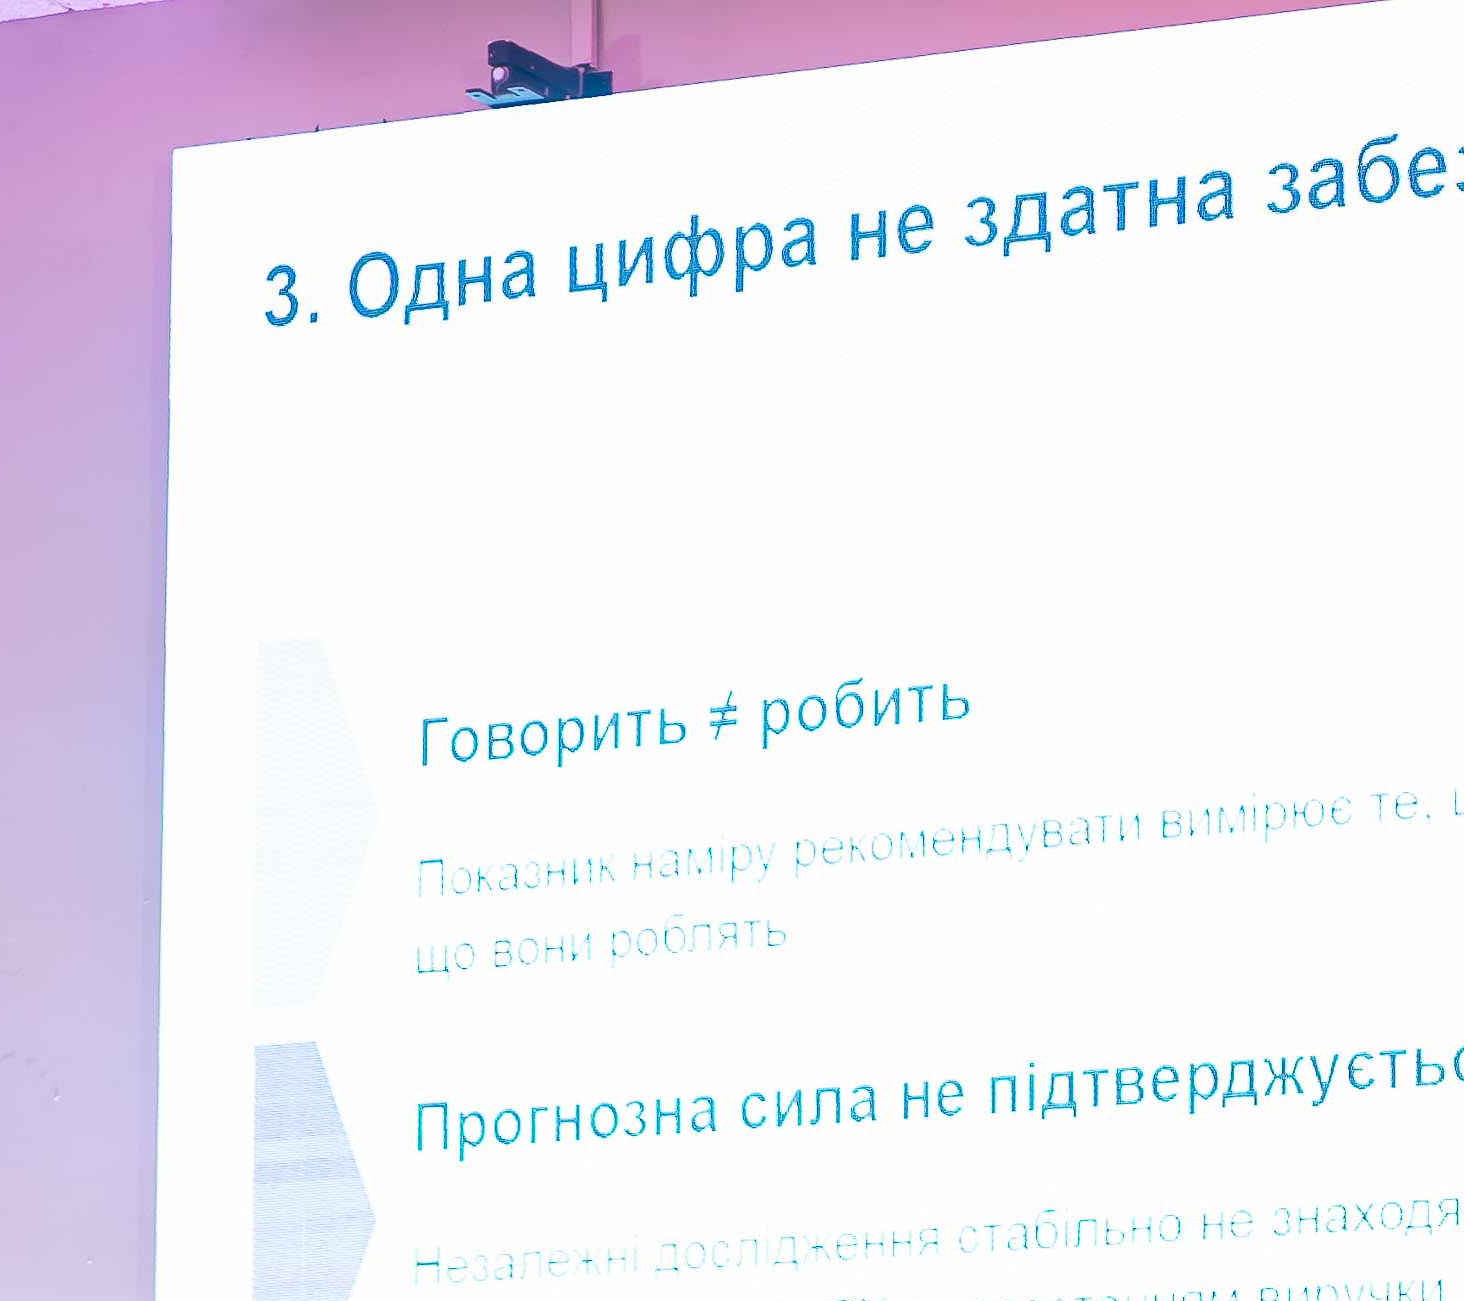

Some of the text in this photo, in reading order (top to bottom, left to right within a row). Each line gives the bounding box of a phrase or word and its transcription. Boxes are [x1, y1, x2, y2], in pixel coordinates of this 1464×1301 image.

[262, 262, 319, 328] 3.
[347, 248, 537, 326] Одна
[566, 212, 817, 304] цифра
[848, 202, 935, 262] не
[963, 168, 1235, 258] здатна
[420, 706, 688, 769] Говорить
[760, 675, 972, 751] робить
[416, 853, 616, 900] Показник
[631, 836, 776, 888] наміру
[793, 811, 1142, 880] рекомендувати
[1158, 790, 1353, 845] вимірює
[414, 912, 788, 981] що вони роблять
[415, 1094, 718, 1164] Прогнозна
[739, 1083, 878, 1130] сила
[901, 1077, 965, 1121] не
[412, 1233, 638, 1288] Незалежні
[652, 1220, 941, 1278] дослідження
[956, 1206, 1183, 1257] стабільно
[1200, 1207, 1255, 1243] не
